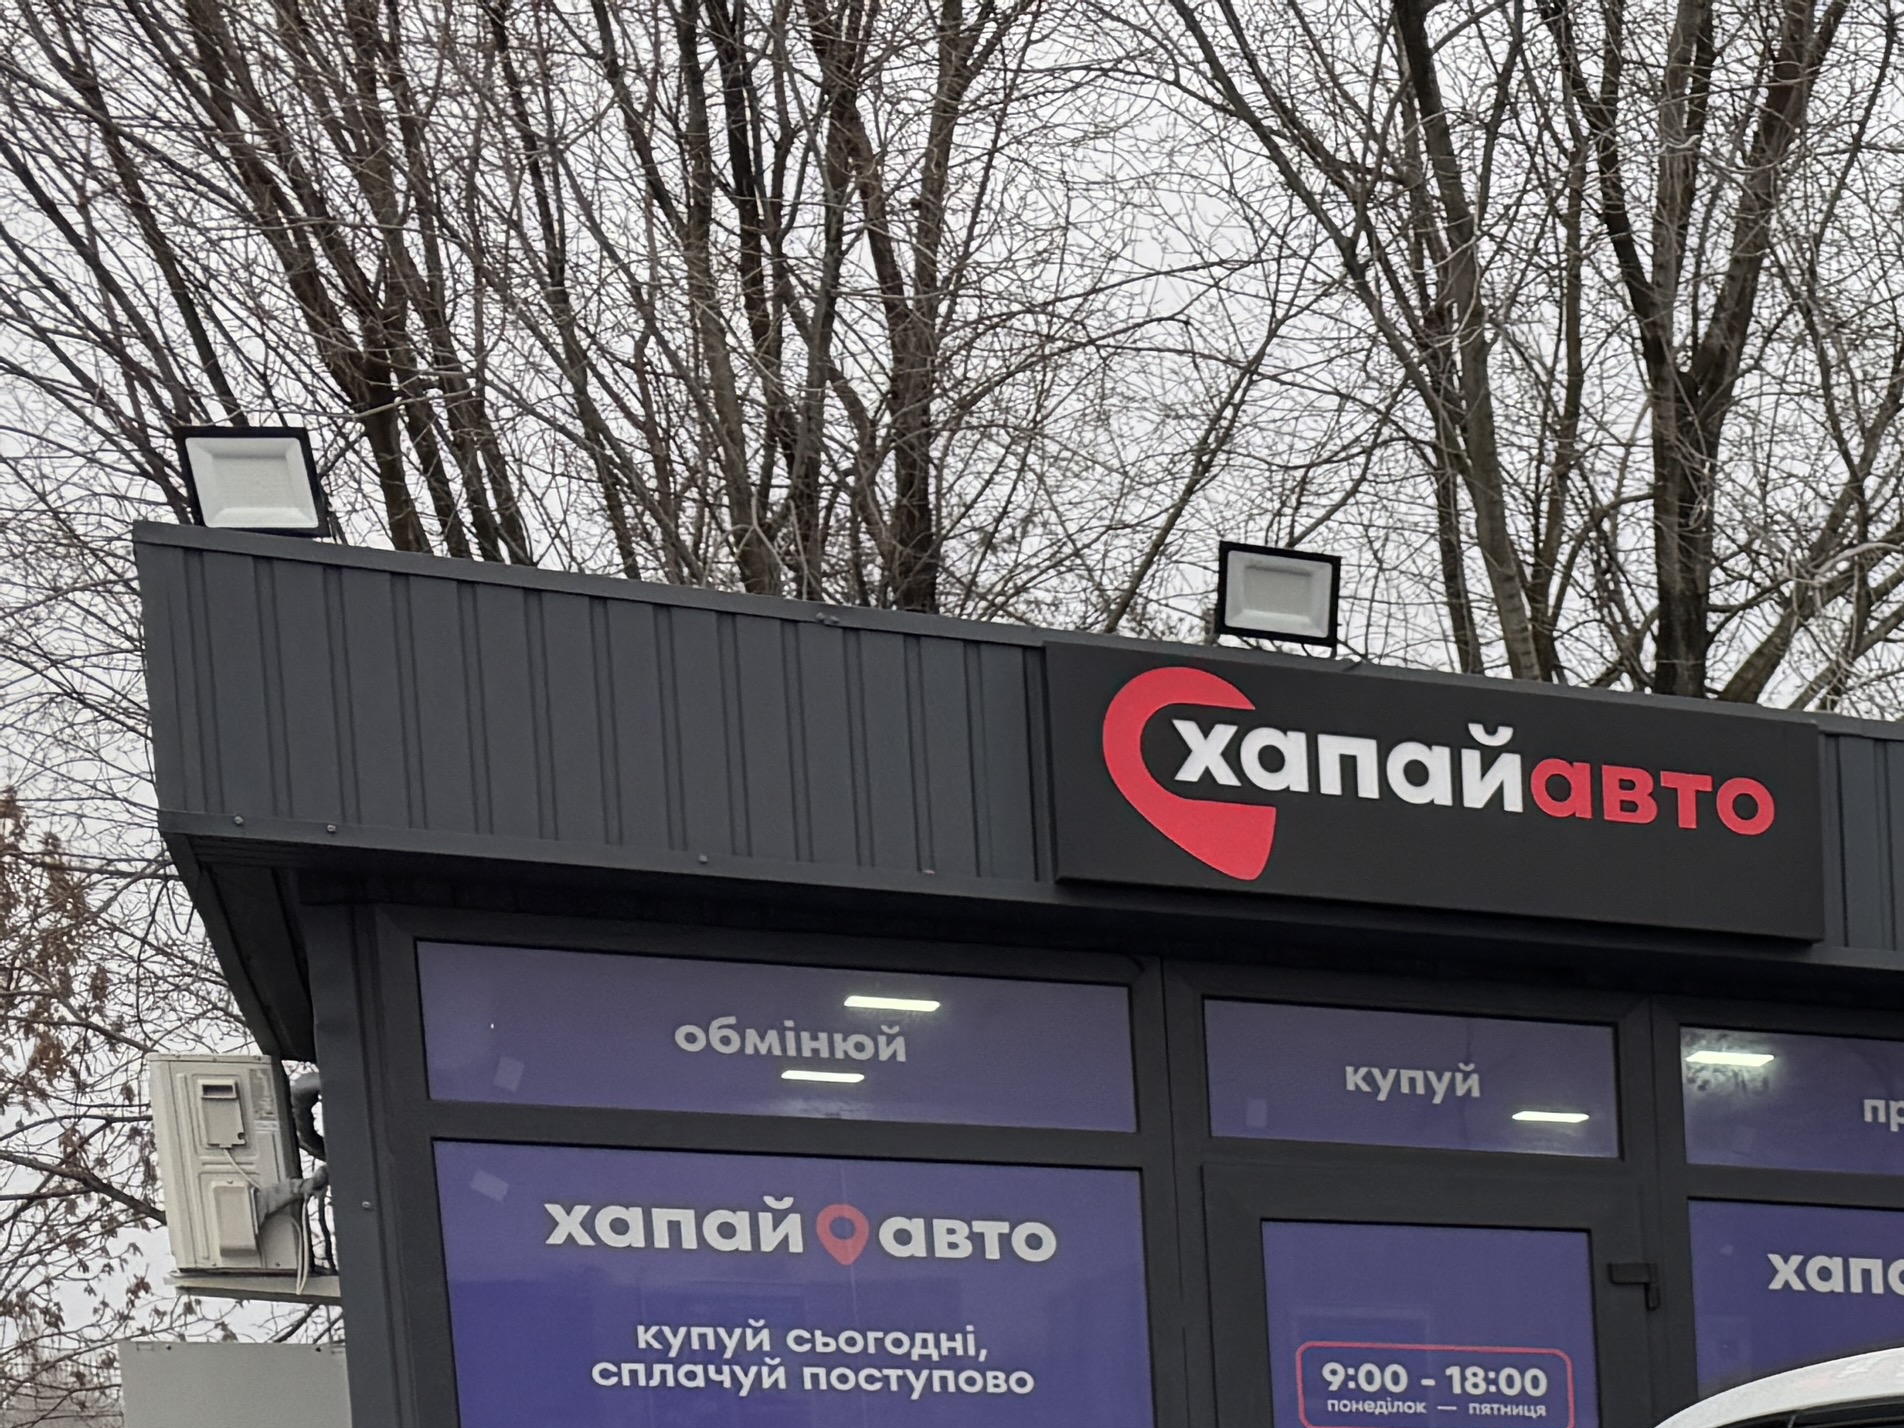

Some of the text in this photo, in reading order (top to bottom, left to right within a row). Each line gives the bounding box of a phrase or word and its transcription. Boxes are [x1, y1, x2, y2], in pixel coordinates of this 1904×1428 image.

[674, 1016, 907, 1062] обмінюй
[1345, 1062, 1481, 1104] купуй
[544, 1196, 1057, 1263] хапай авто
[636, 1319, 988, 1362] купуй сьогодні,
[591, 1357, 1035, 1400] сплачуй поступово
[1322, 1362, 1408, 1393] 9:00
[1445, 1366, 1548, 1397] 18:00
[1327, 1398, 1427, 1415] понеділок
[1469, 1402, 1547, 1418] пятниця
